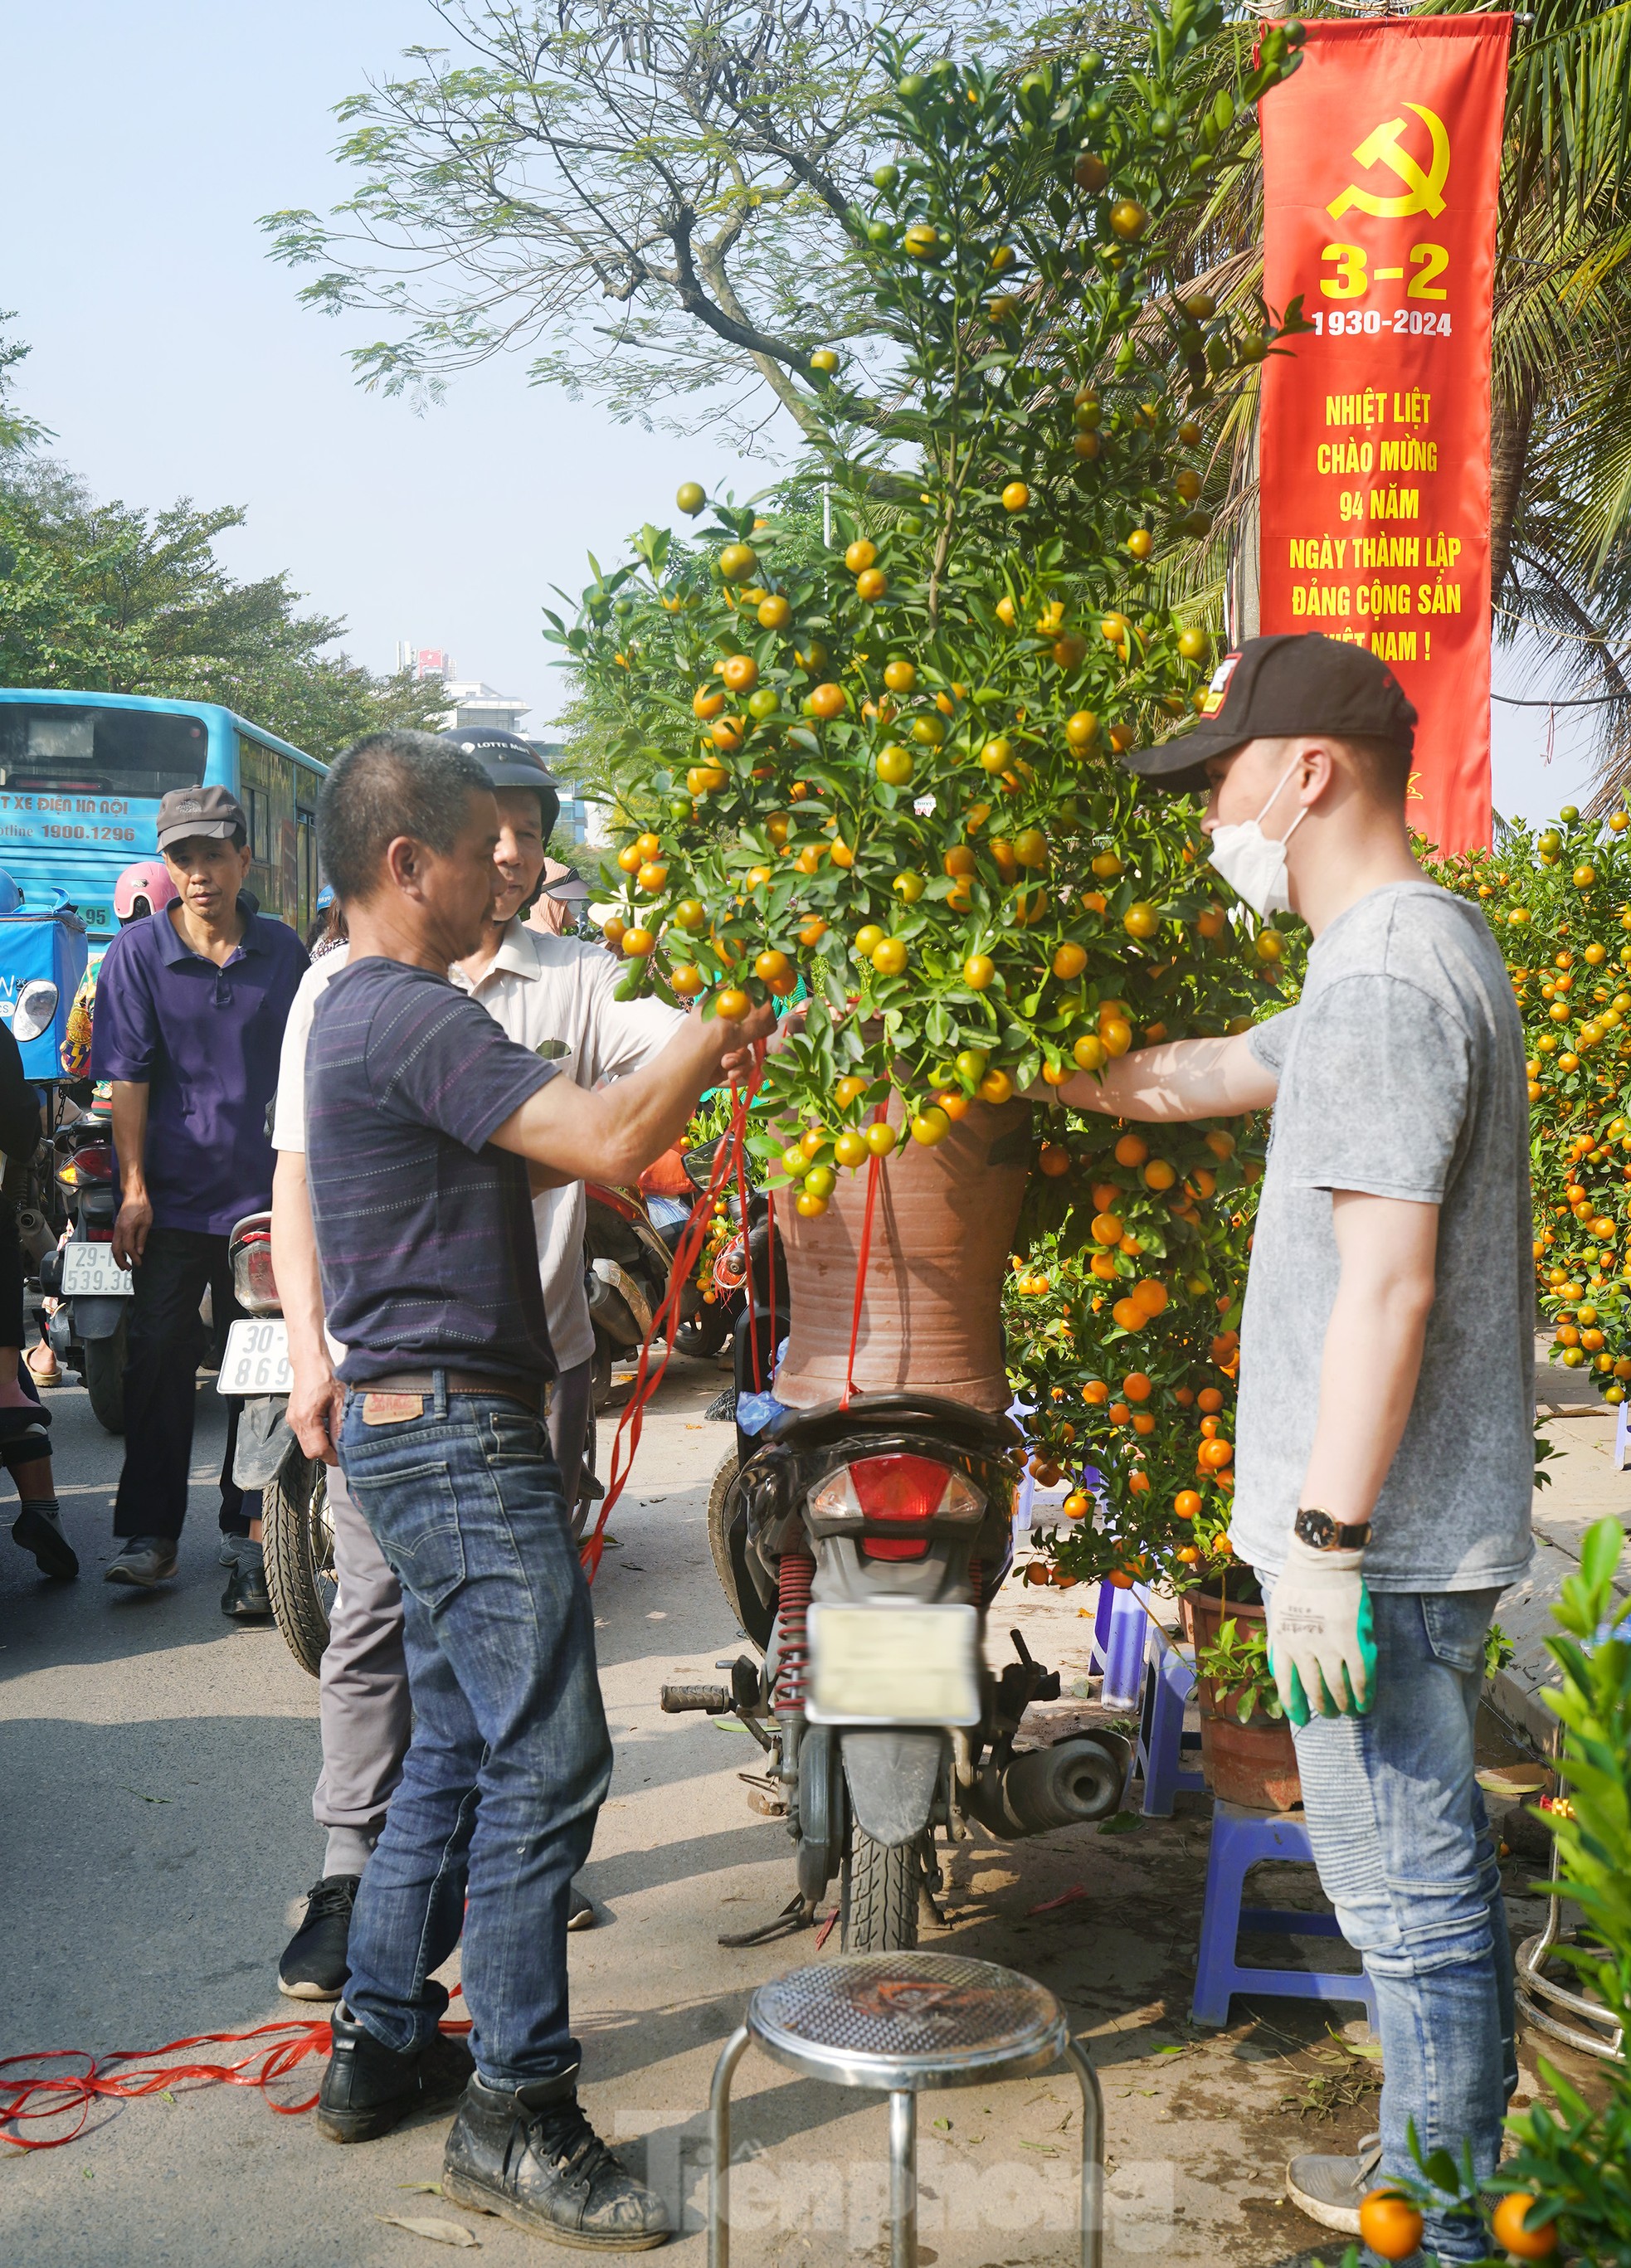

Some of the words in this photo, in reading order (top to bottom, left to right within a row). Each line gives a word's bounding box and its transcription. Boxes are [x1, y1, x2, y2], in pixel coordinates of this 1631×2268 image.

[1320, 243, 1449, 300] 3-2
[1311, 309, 1452, 337] 1930-2024
[1326, 387, 1388, 431] NHIỆT
[1394, 386, 1431, 430] LIỆT
[1317, 436, 1373, 474] CHÀO
[1380, 433, 1437, 472] MỪNG
[1339, 491, 1364, 522] 94
[1370, 483, 1419, 519] NĂM
[1289, 533, 1347, 569] NGÀY
[1352, 531, 1419, 567] THÀNH
[1425, 531, 1462, 573] LẬP
[1292, 577, 1351, 616] ĐẢNG
[1356, 578, 1411, 621] CỘNG
[1417, 576, 1461, 614] SẢN
[1371, 631, 1417, 661] NAM
[14, 796, 32, 810] XE
[75, 796, 96, 813] HÀ
[41, 825, 135, 841] 1900.1296
[85, 908, 106, 925] 95
[242, 1325, 290, 1354] 30-
